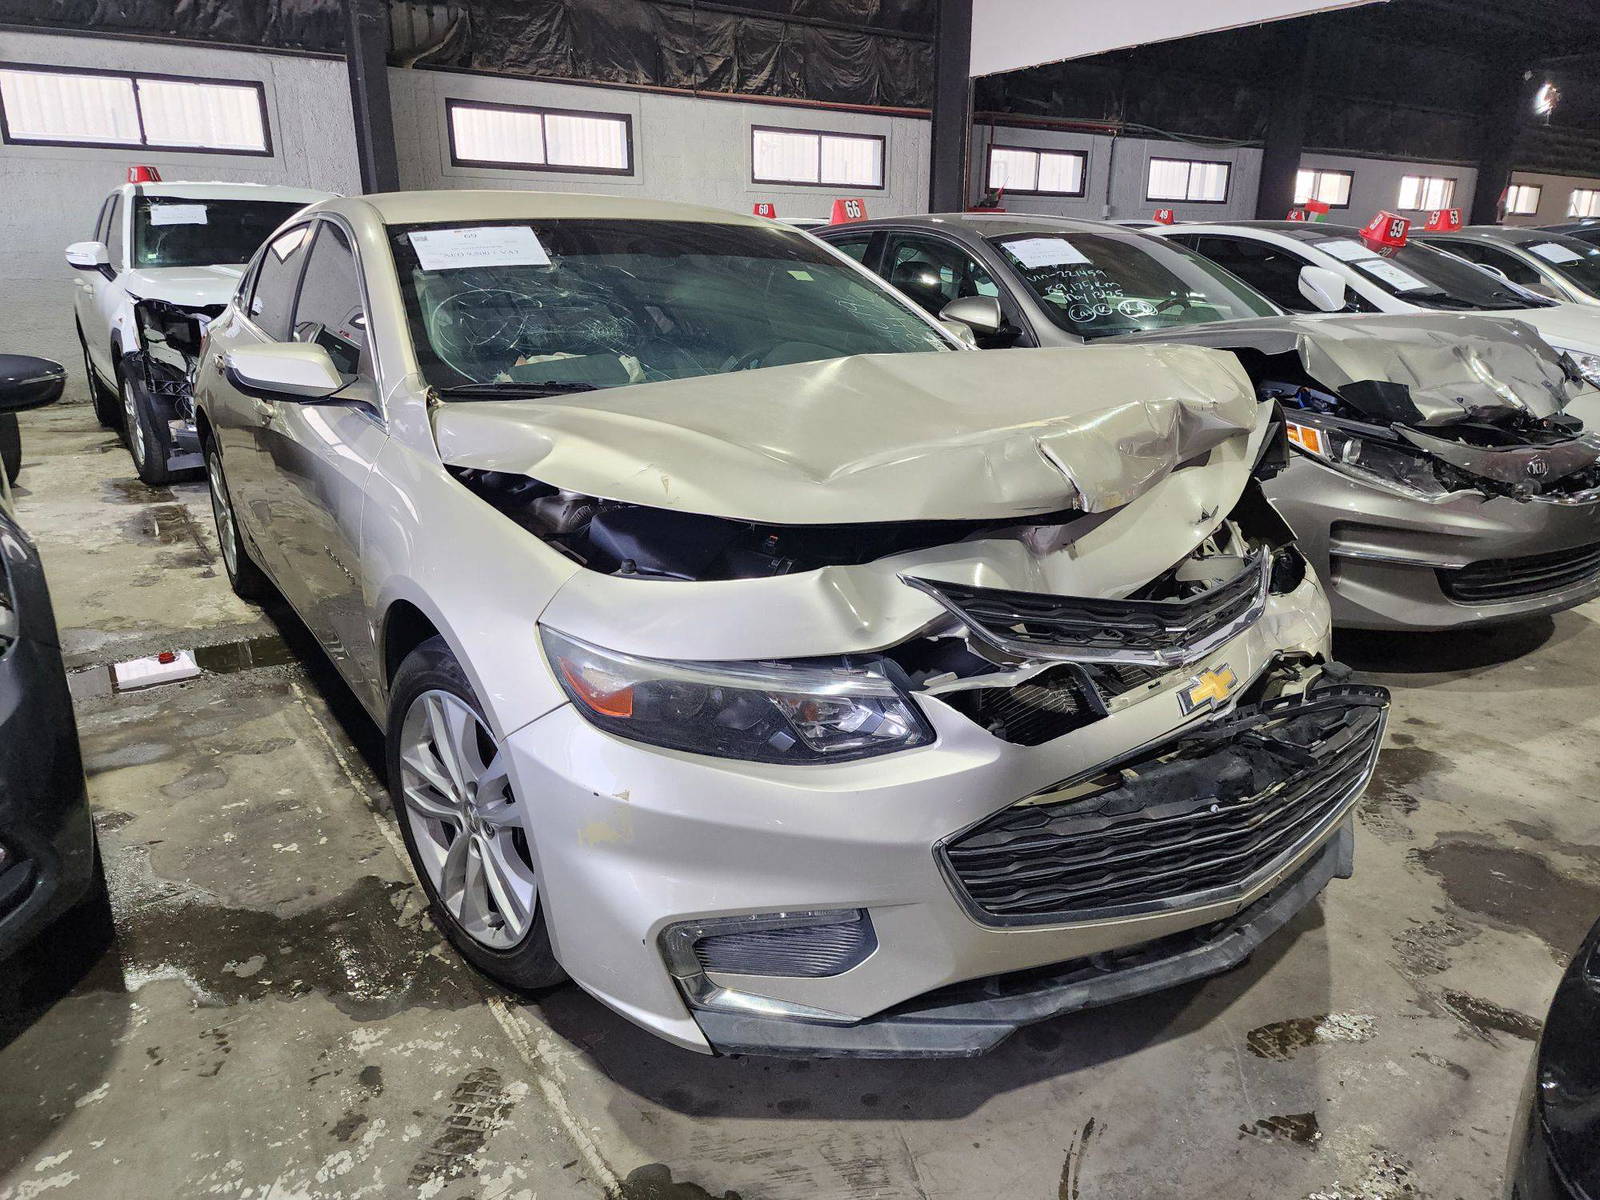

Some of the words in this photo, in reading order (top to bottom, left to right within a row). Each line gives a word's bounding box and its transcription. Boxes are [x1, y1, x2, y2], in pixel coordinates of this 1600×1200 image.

[845, 200, 861, 218] 66
[1449, 210, 1459, 224] 53
[1390, 219, 1405, 237] 59
